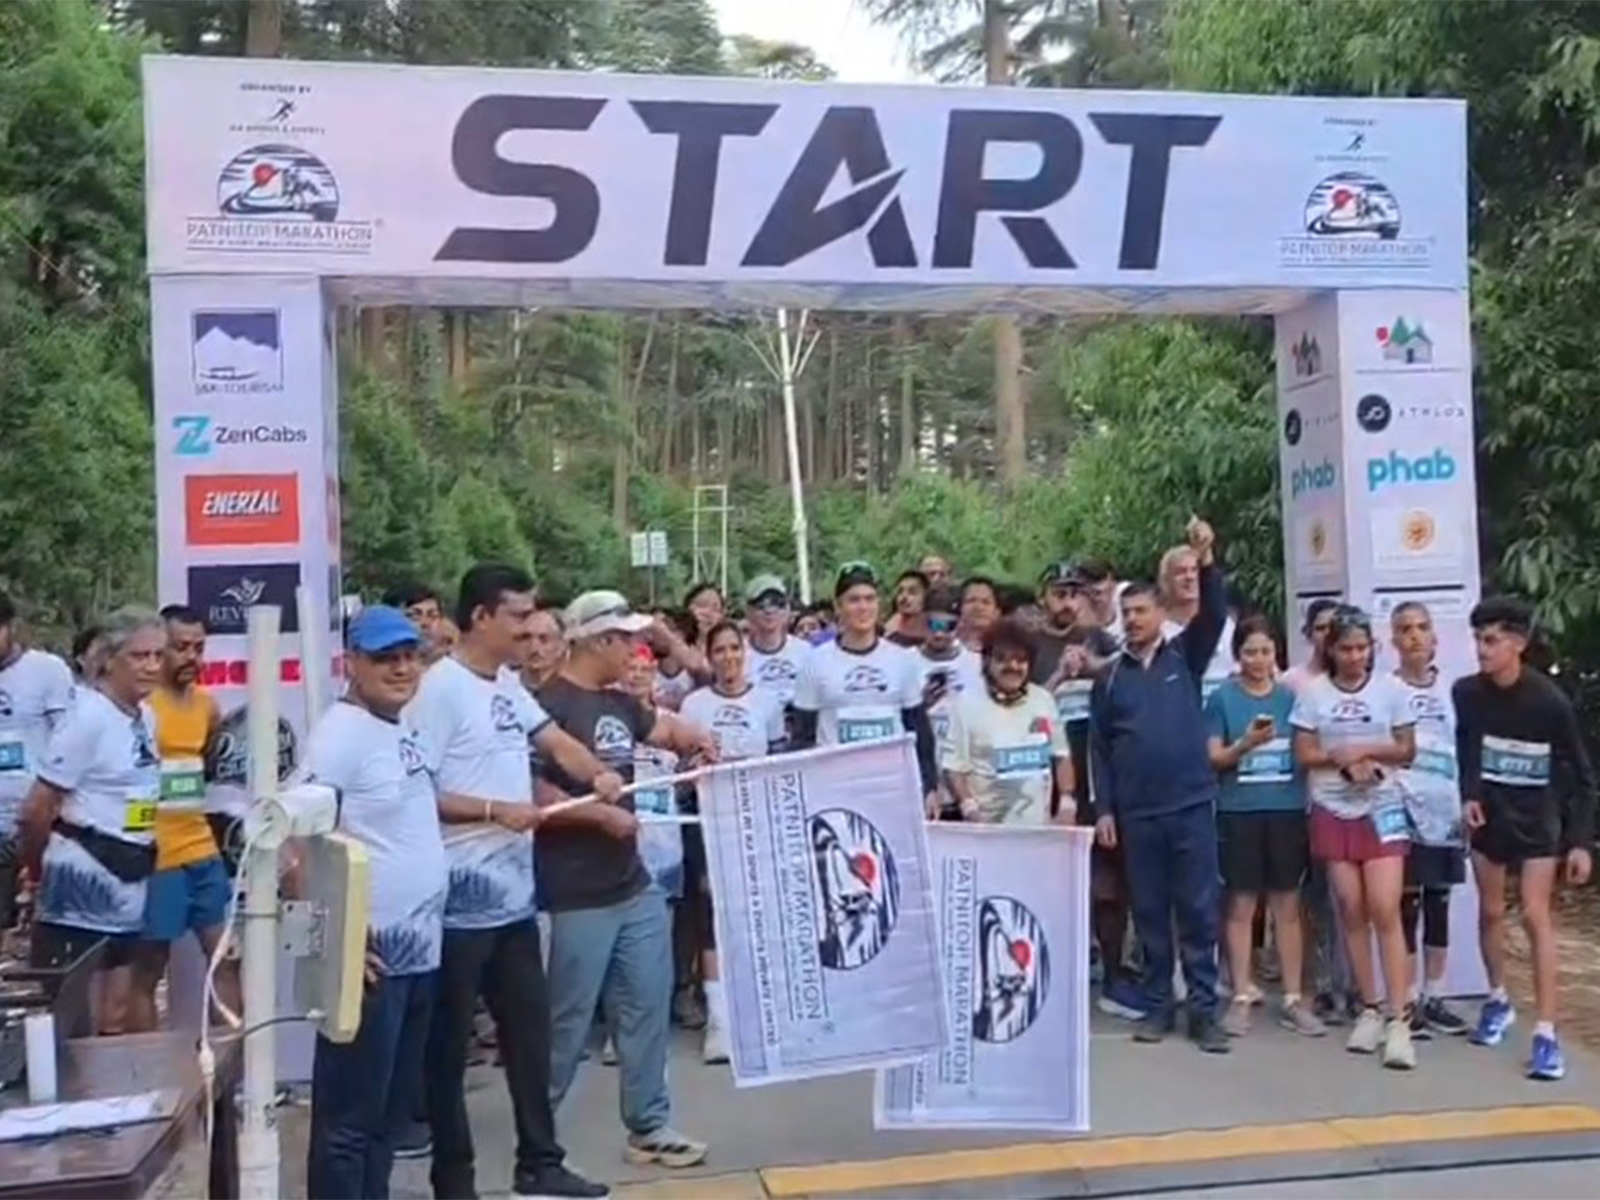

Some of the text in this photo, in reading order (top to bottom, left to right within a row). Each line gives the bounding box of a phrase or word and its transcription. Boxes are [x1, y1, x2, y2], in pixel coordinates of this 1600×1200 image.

[434, 94, 1223, 270] START
[274, 225, 372, 240] MARATHON
[215, 426, 308, 444] ZenCabs
[1292, 457, 1335, 500] phab
[1368, 450, 1456, 492] phab
[201, 488, 281, 517] ENERZAL
[781, 773, 807, 884] PATNITOP
[796, 890, 823, 1020] MARATHON
[953, 858, 972, 1085] PATNITOP MARATHON
